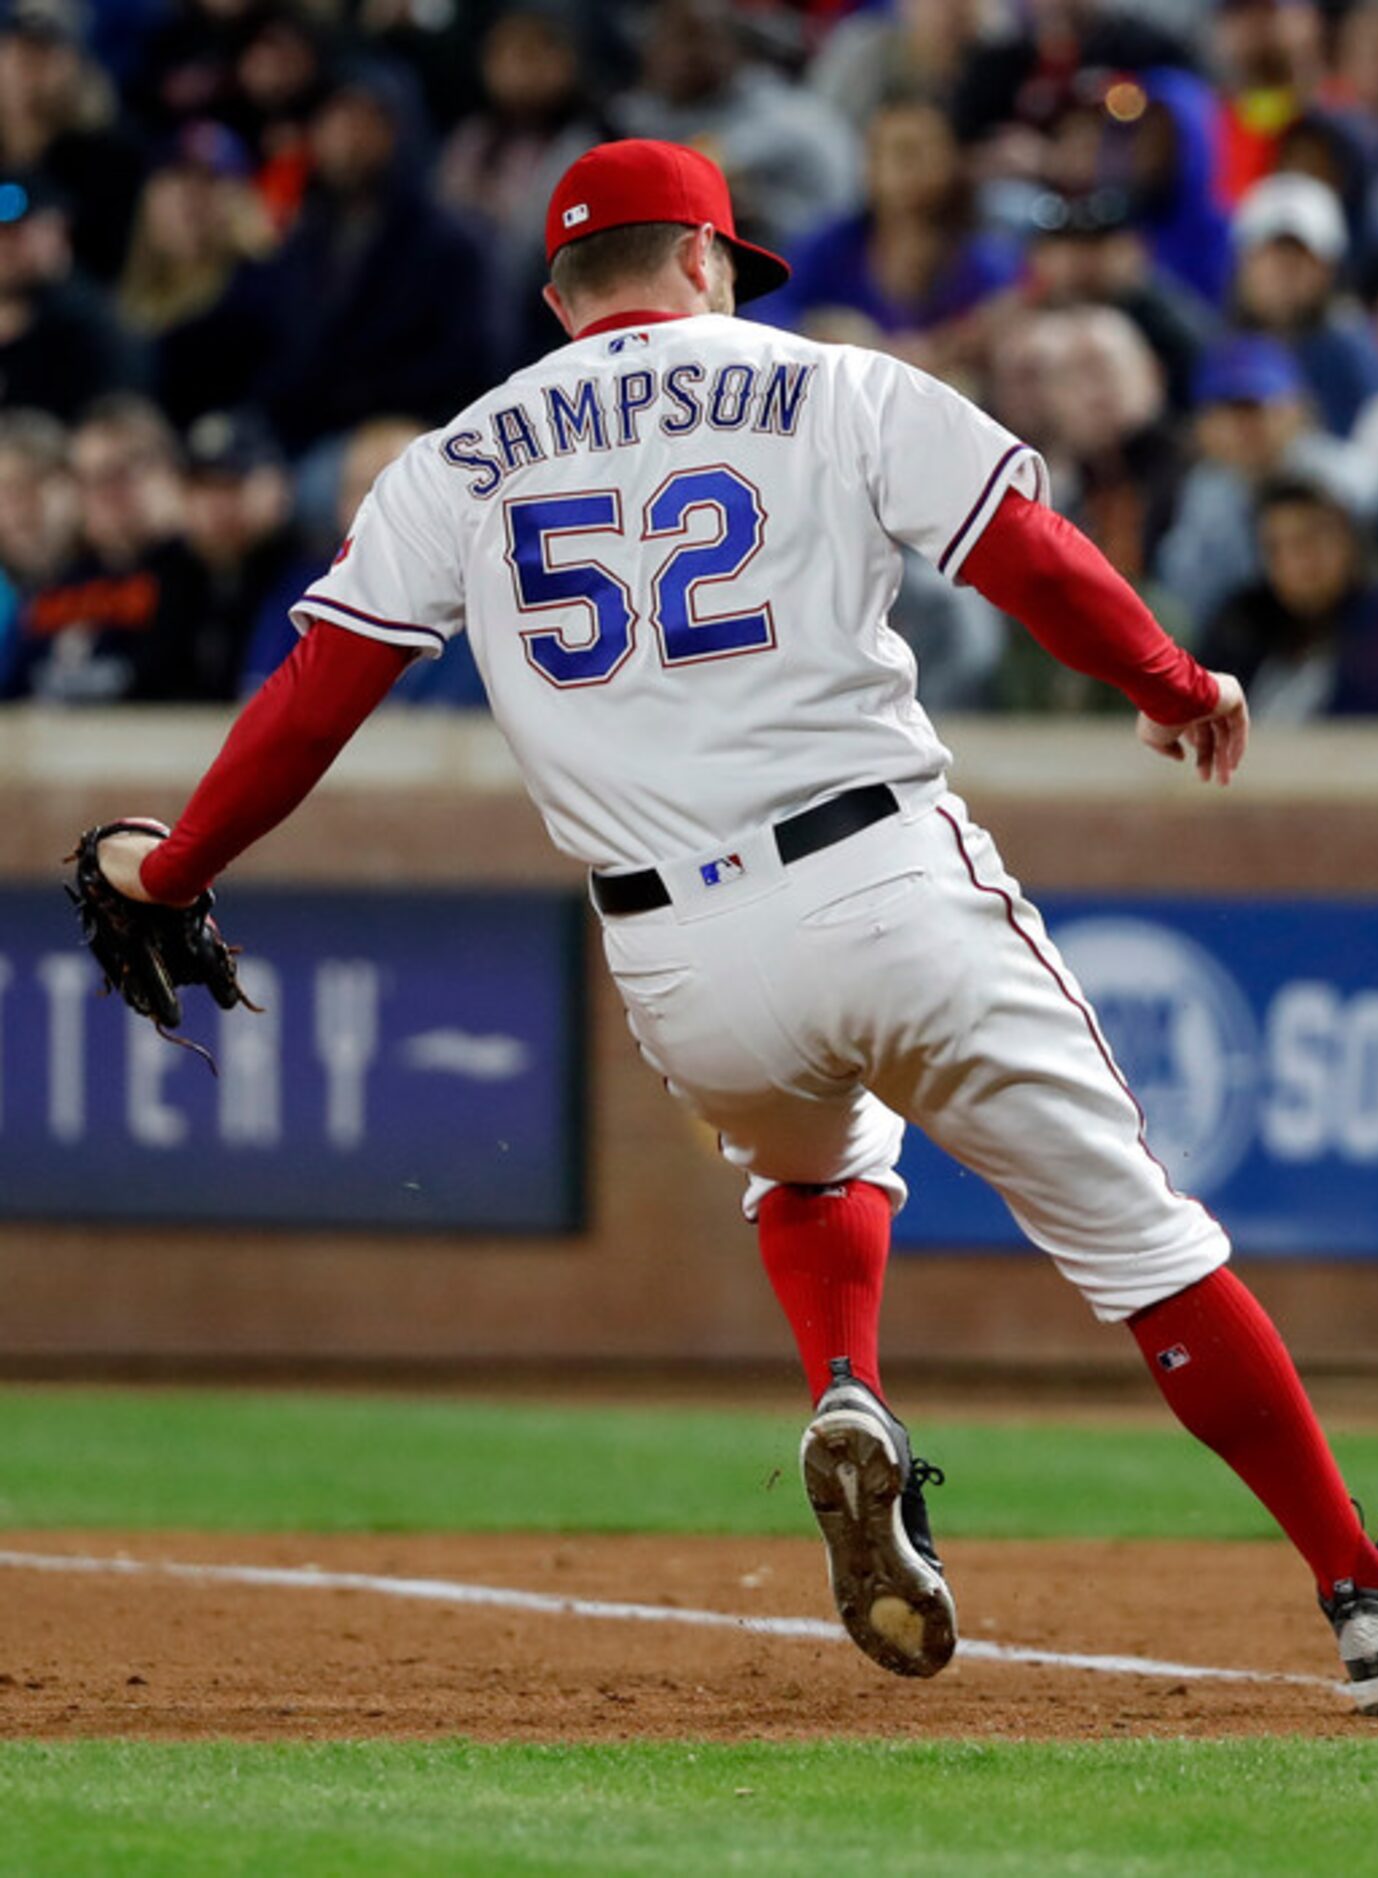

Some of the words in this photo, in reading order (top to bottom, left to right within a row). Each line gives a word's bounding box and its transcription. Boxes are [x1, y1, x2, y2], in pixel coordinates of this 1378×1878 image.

[440, 360, 817, 500] SAMPSON
[503, 462, 777, 690] 52
[0, 953, 380, 1148] TERY
